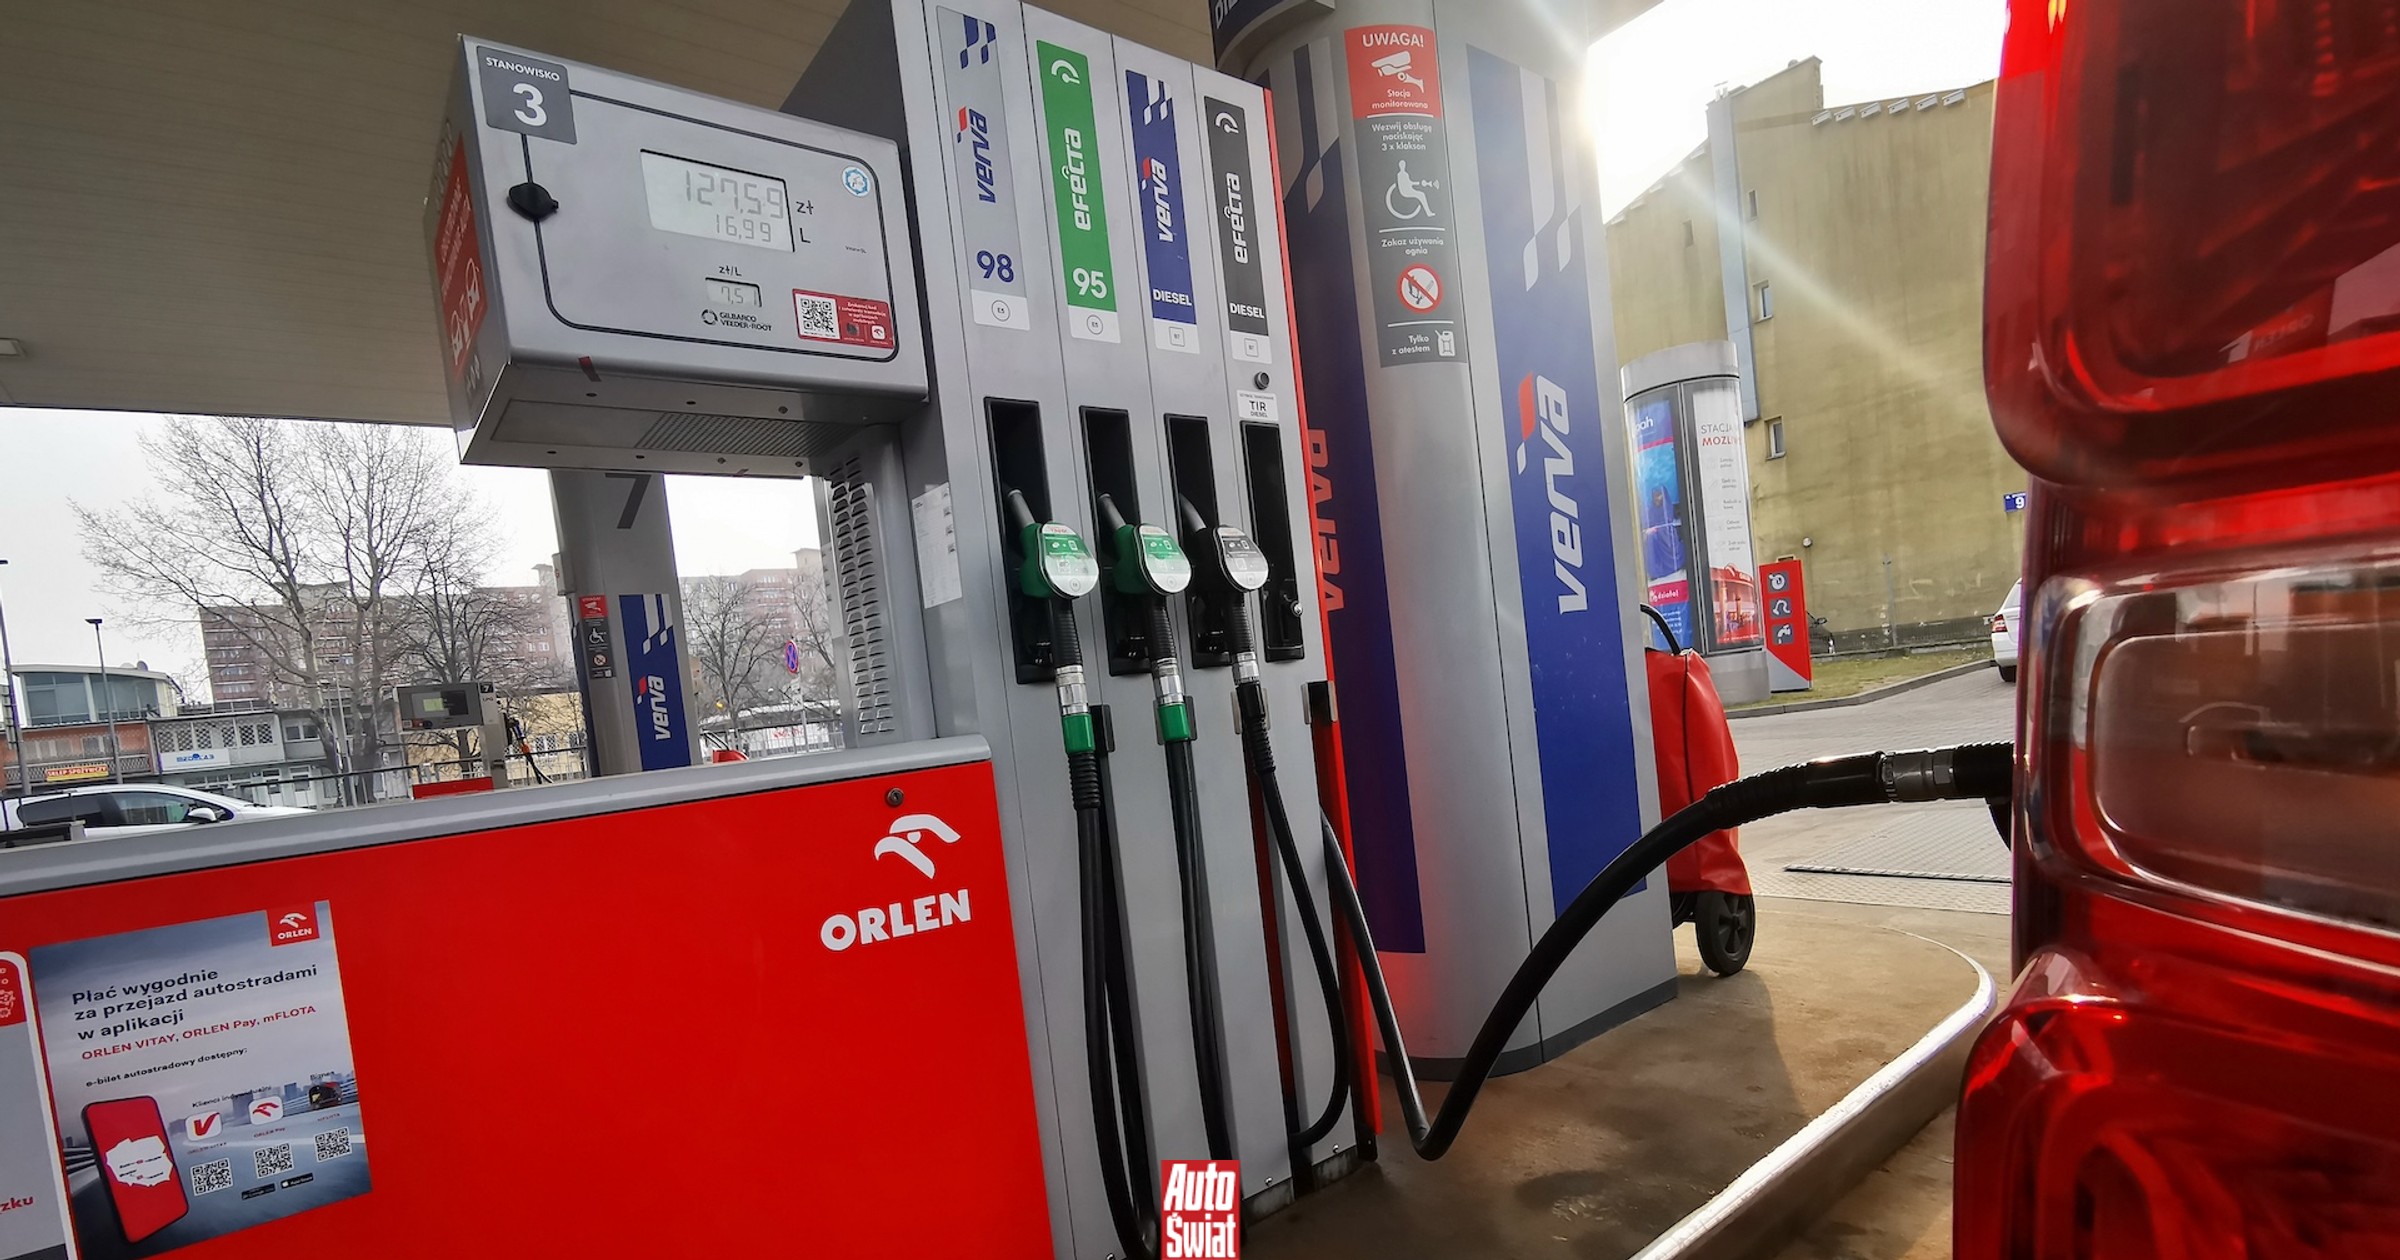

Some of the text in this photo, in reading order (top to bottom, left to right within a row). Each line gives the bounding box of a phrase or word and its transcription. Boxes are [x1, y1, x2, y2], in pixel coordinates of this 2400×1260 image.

[1362, 32, 1424, 48] UWAGA!
[486, 57, 560, 81] STANOWISKO
[513, 83, 547, 126] 3
[1372, 100, 1429, 109] monitorowana
[1387, 89, 1411, 98] Stacja
[1372, 122, 1401, 132] Wezwij
[968, 108, 996, 203] verva
[1381, 143, 1388, 151] 3
[1396, 142, 1426, 151] klakson
[685, 170, 784, 219] 127,59
[1151, 158, 1173, 242] verva
[716, 214, 811, 243] 16,99 L
[1381, 238, 1407, 248] Zakaz
[1405, 247, 1428, 256] ognia
[976, 250, 1014, 283] 98
[1073, 268, 1107, 299] 95
[1153, 288, 1192, 306] DIESEL
[719, 312, 757, 322] GILBARCO
[1230, 302, 1265, 319] DIESEL
[1398, 344, 1430, 355] atestem
[1408, 335, 1430, 345] Tylko
[1249, 400, 1266, 411] TIR
[605, 473, 651, 529] 7
[1537, 375, 1588, 615] verva
[648, 675, 671, 740] verva
[277, 928, 312, 939] ORLEN
[820, 889, 971, 951] ORLEN
[72, 969, 218, 1004] Płać wygodnie
[74, 964, 317, 1021] za przejazd autostradami
[78, 1009, 184, 1041] w aplikacji
[82, 1005, 316, 1060] ORLEN VITAY, ORLEN Pay, mFLOTA
[86, 1074, 122, 1087] e-bilet
[124, 1058, 196, 1078] autostradowy
